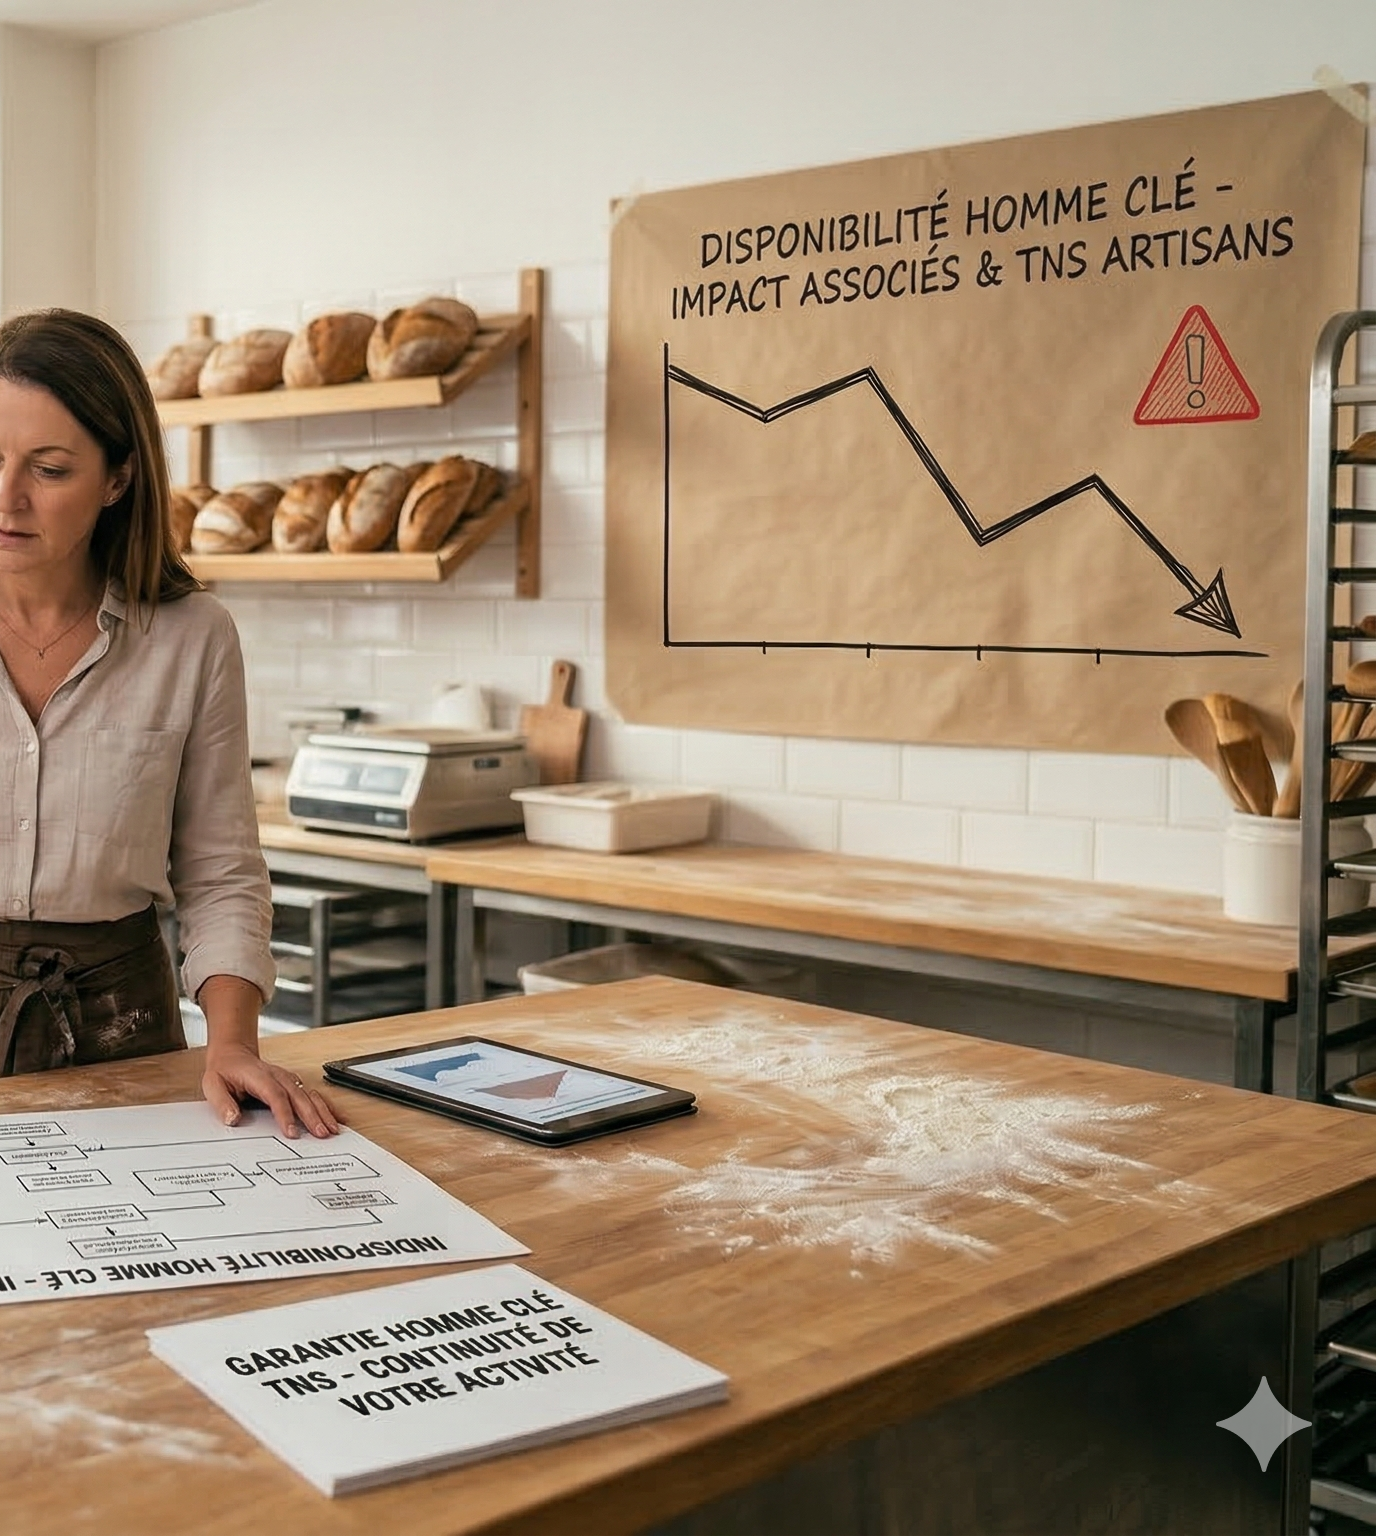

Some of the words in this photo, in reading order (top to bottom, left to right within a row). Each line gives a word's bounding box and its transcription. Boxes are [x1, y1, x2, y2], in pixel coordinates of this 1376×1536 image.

[701, 188, 949, 269] DISPONIBILITÉ
[966, 181, 1109, 237] HOMME
[1124, 156, 1198, 217] CLÉ
[671, 270, 791, 320] IMPACT
[799, 243, 960, 307] ASSOCIÉS
[976, 249, 1003, 288] &
[1015, 240, 1087, 283] TNS
[1101, 215, 1295, 275] ARTISANS
[40, 1268, 97, 1291] CLÉ
[100, 1257, 217, 1281] HOMME
[216, 1236, 448, 1275] INDISPONIBILITÉ
[225, 1328, 389, 1376] GARANTIE
[383, 1305, 507, 1343] HOMME
[500, 1289, 566, 1317] CLÉ
[260, 1371, 342, 1400] TNS
[359, 1325, 549, 1379] CONTINUITÉ
[539, 1316, 593, 1339] DE
[338, 1376, 458, 1416] VOTRE
[455, 1344, 600, 1392] ACTIVITÉ
